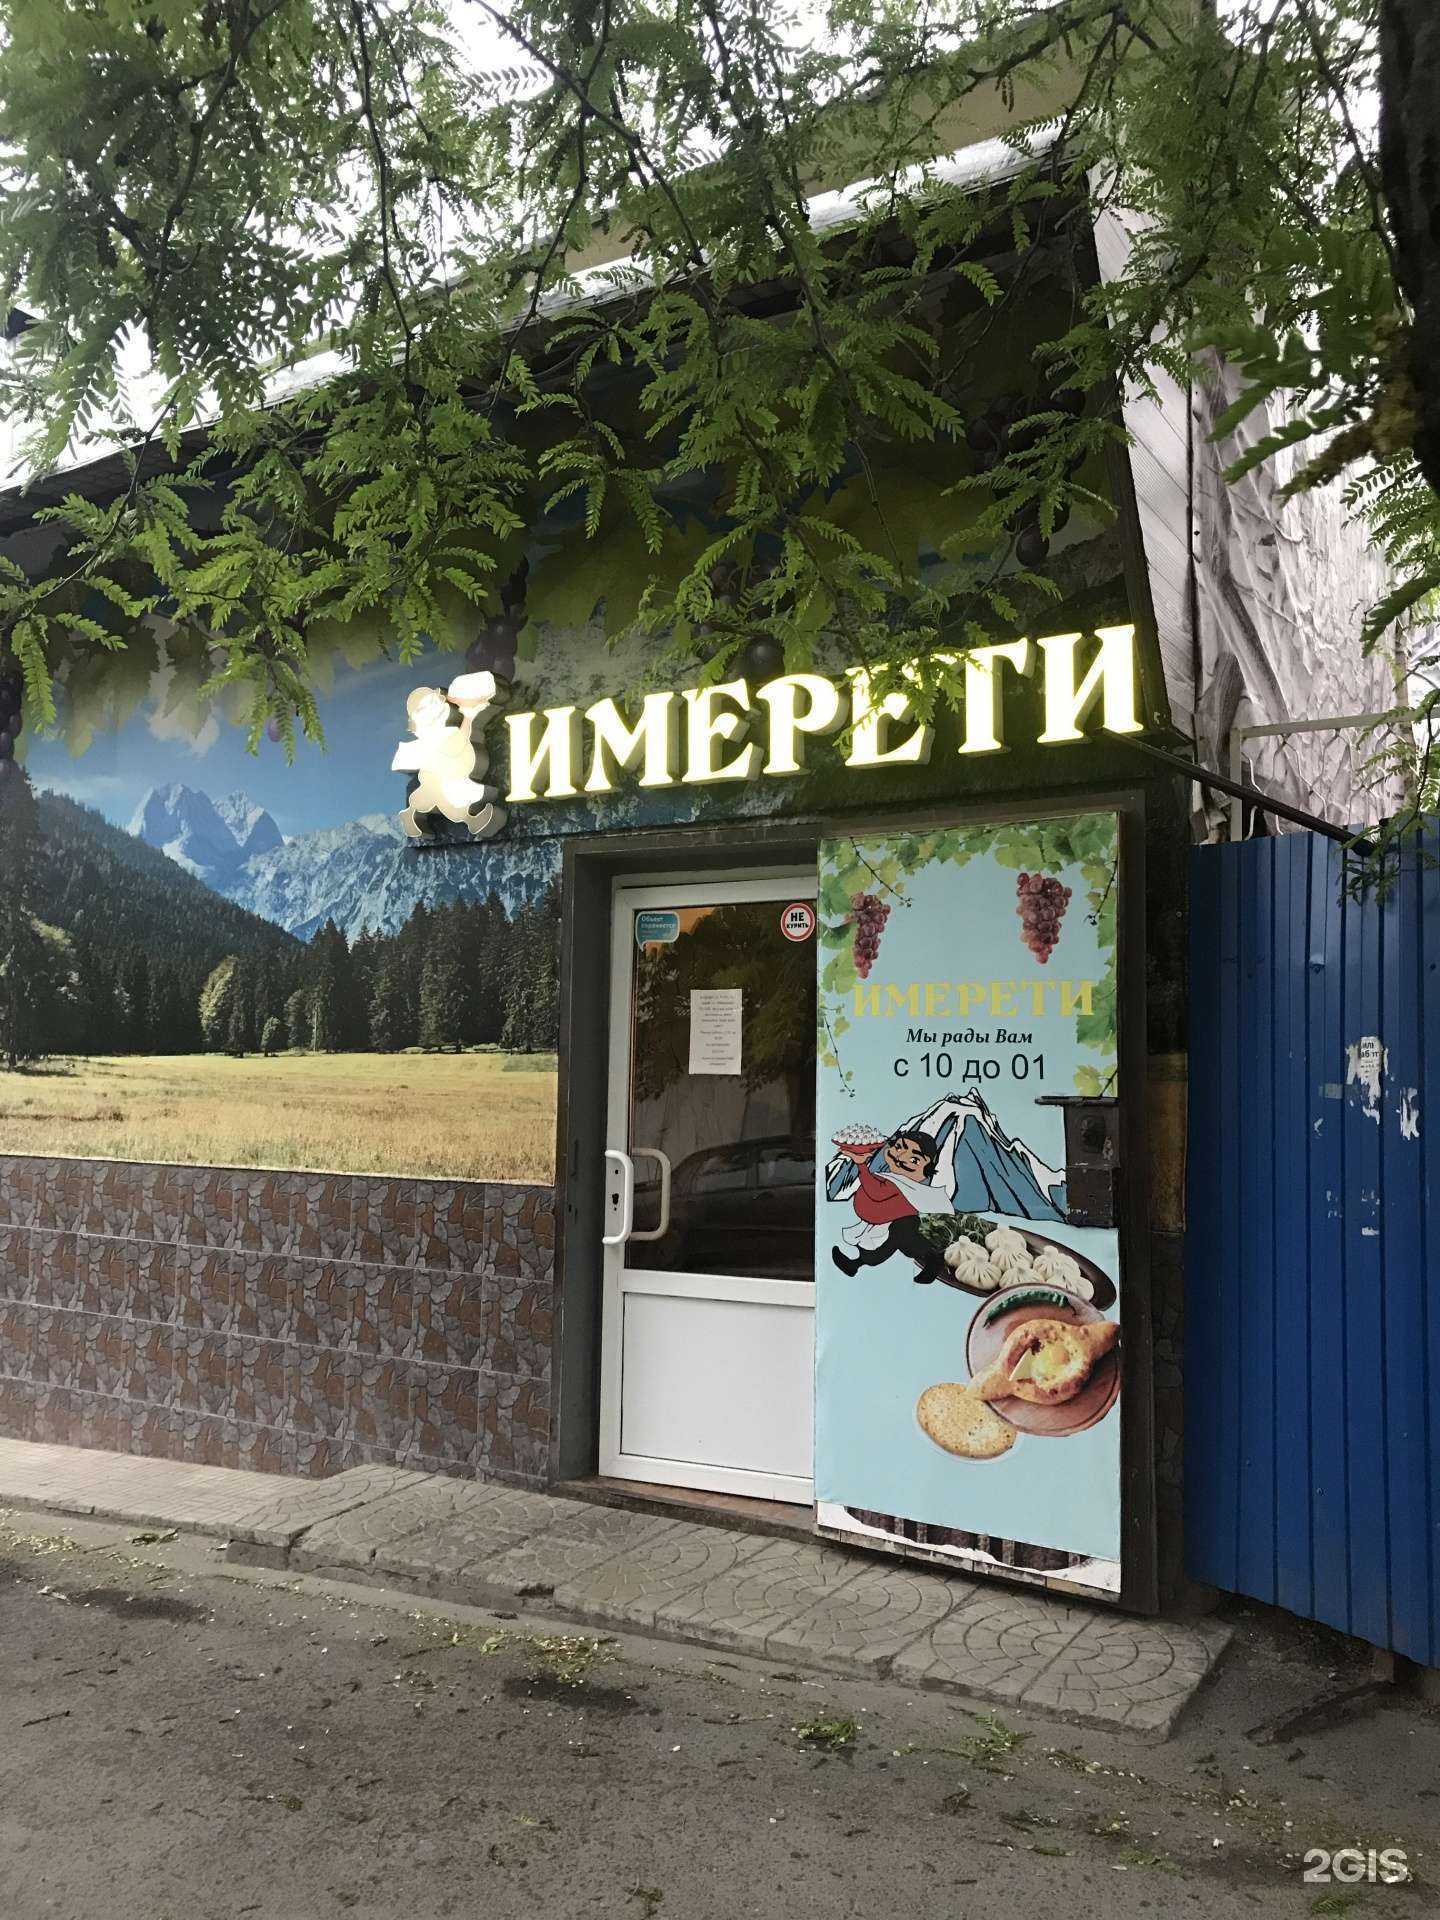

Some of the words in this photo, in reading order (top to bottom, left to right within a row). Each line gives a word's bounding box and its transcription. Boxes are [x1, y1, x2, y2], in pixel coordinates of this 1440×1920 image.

[504, 624, 1144, 803] ИМЕРЕТИ
[790, 912, 805, 922] НЕ
[852, 980, 1095, 1018] ИМЕРЕТИ
[906, 1028, 937, 1044] Мы
[941, 1028, 990, 1047] рады
[995, 1028, 1033, 1044] Вам
[893, 1058, 910, 1077] с
[920, 1052, 953, 1079] 10
[962, 1059, 1001, 1083] до
[1011, 1053, 1045, 1080] 01
